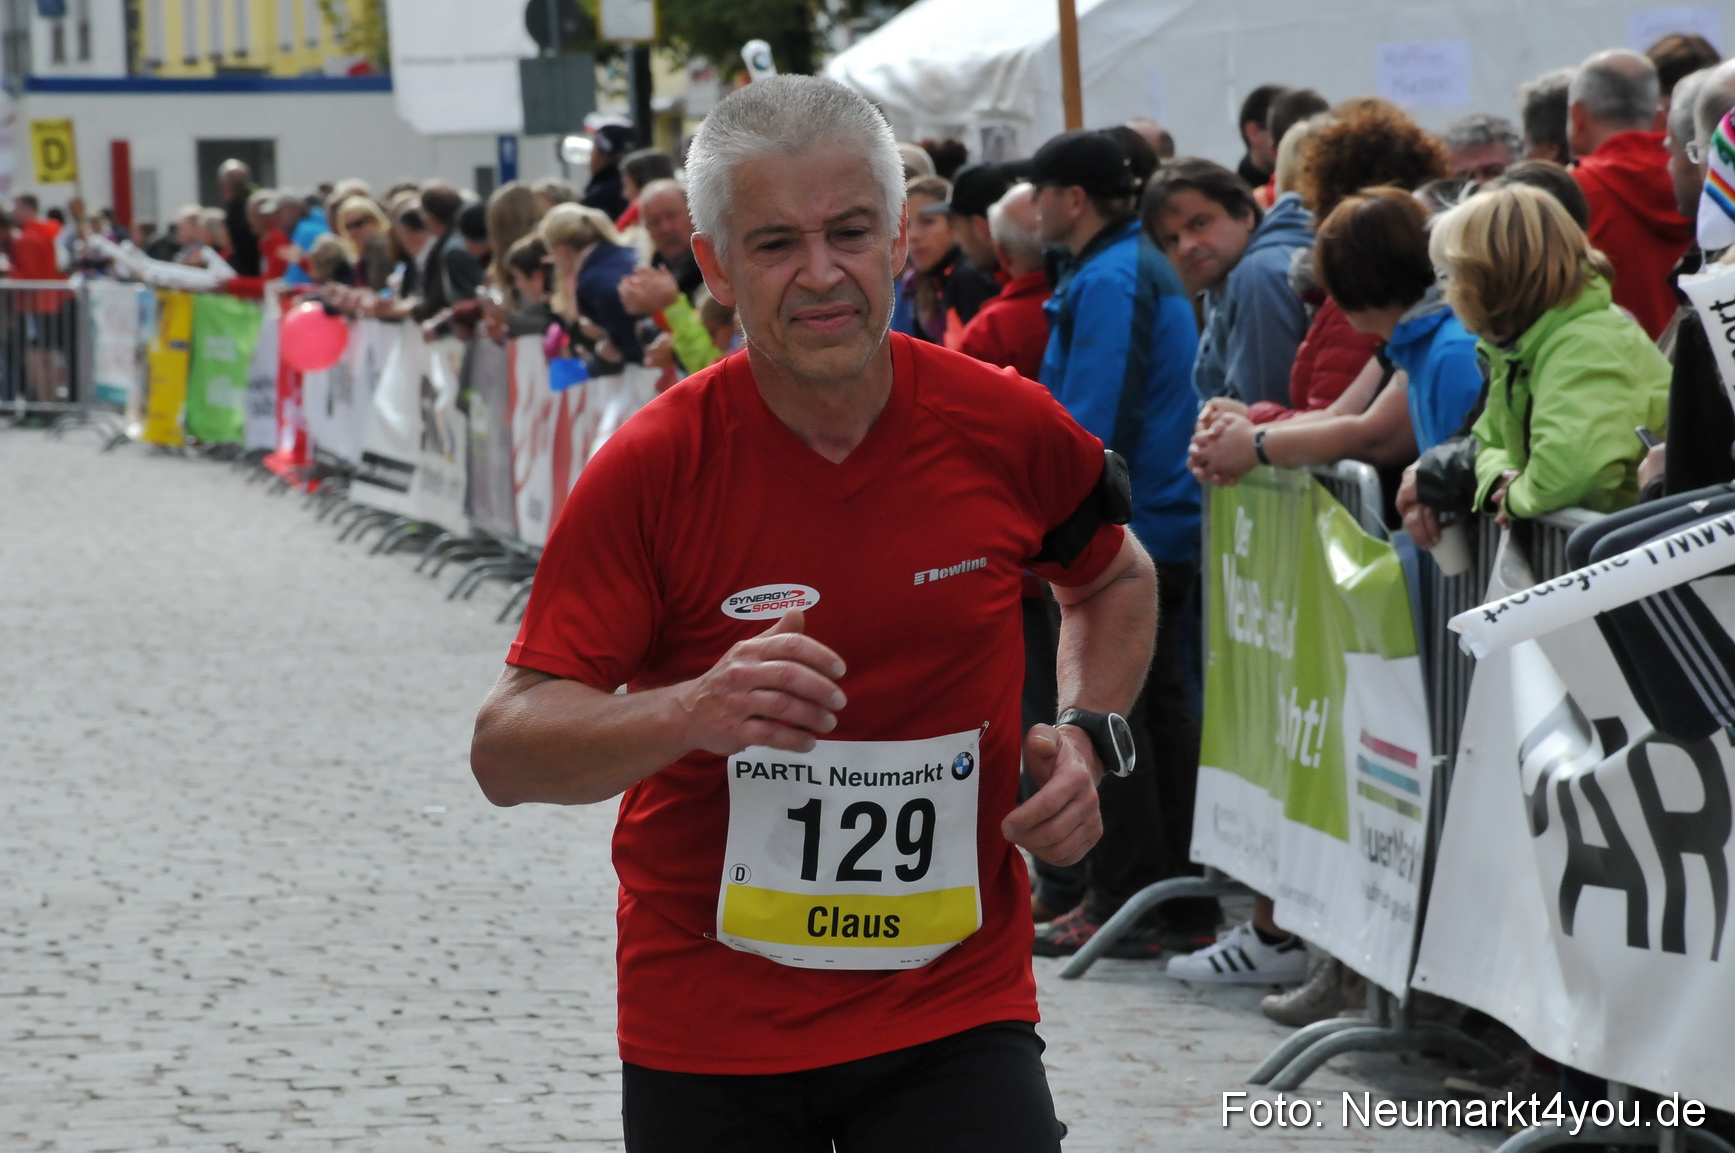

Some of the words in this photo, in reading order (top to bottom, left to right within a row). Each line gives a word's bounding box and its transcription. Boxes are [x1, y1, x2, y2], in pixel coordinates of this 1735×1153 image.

[42, 137, 68, 170] D
[729, 590, 790, 605] SYNERGY
[752, 599, 805, 613] SPORTS
[736, 761, 822, 785] PARTL
[829, 763, 943, 786] Neumarkt
[787, 798, 936, 882] 129
[735, 867, 745, 881] D
[807, 906, 900, 938] Claus
